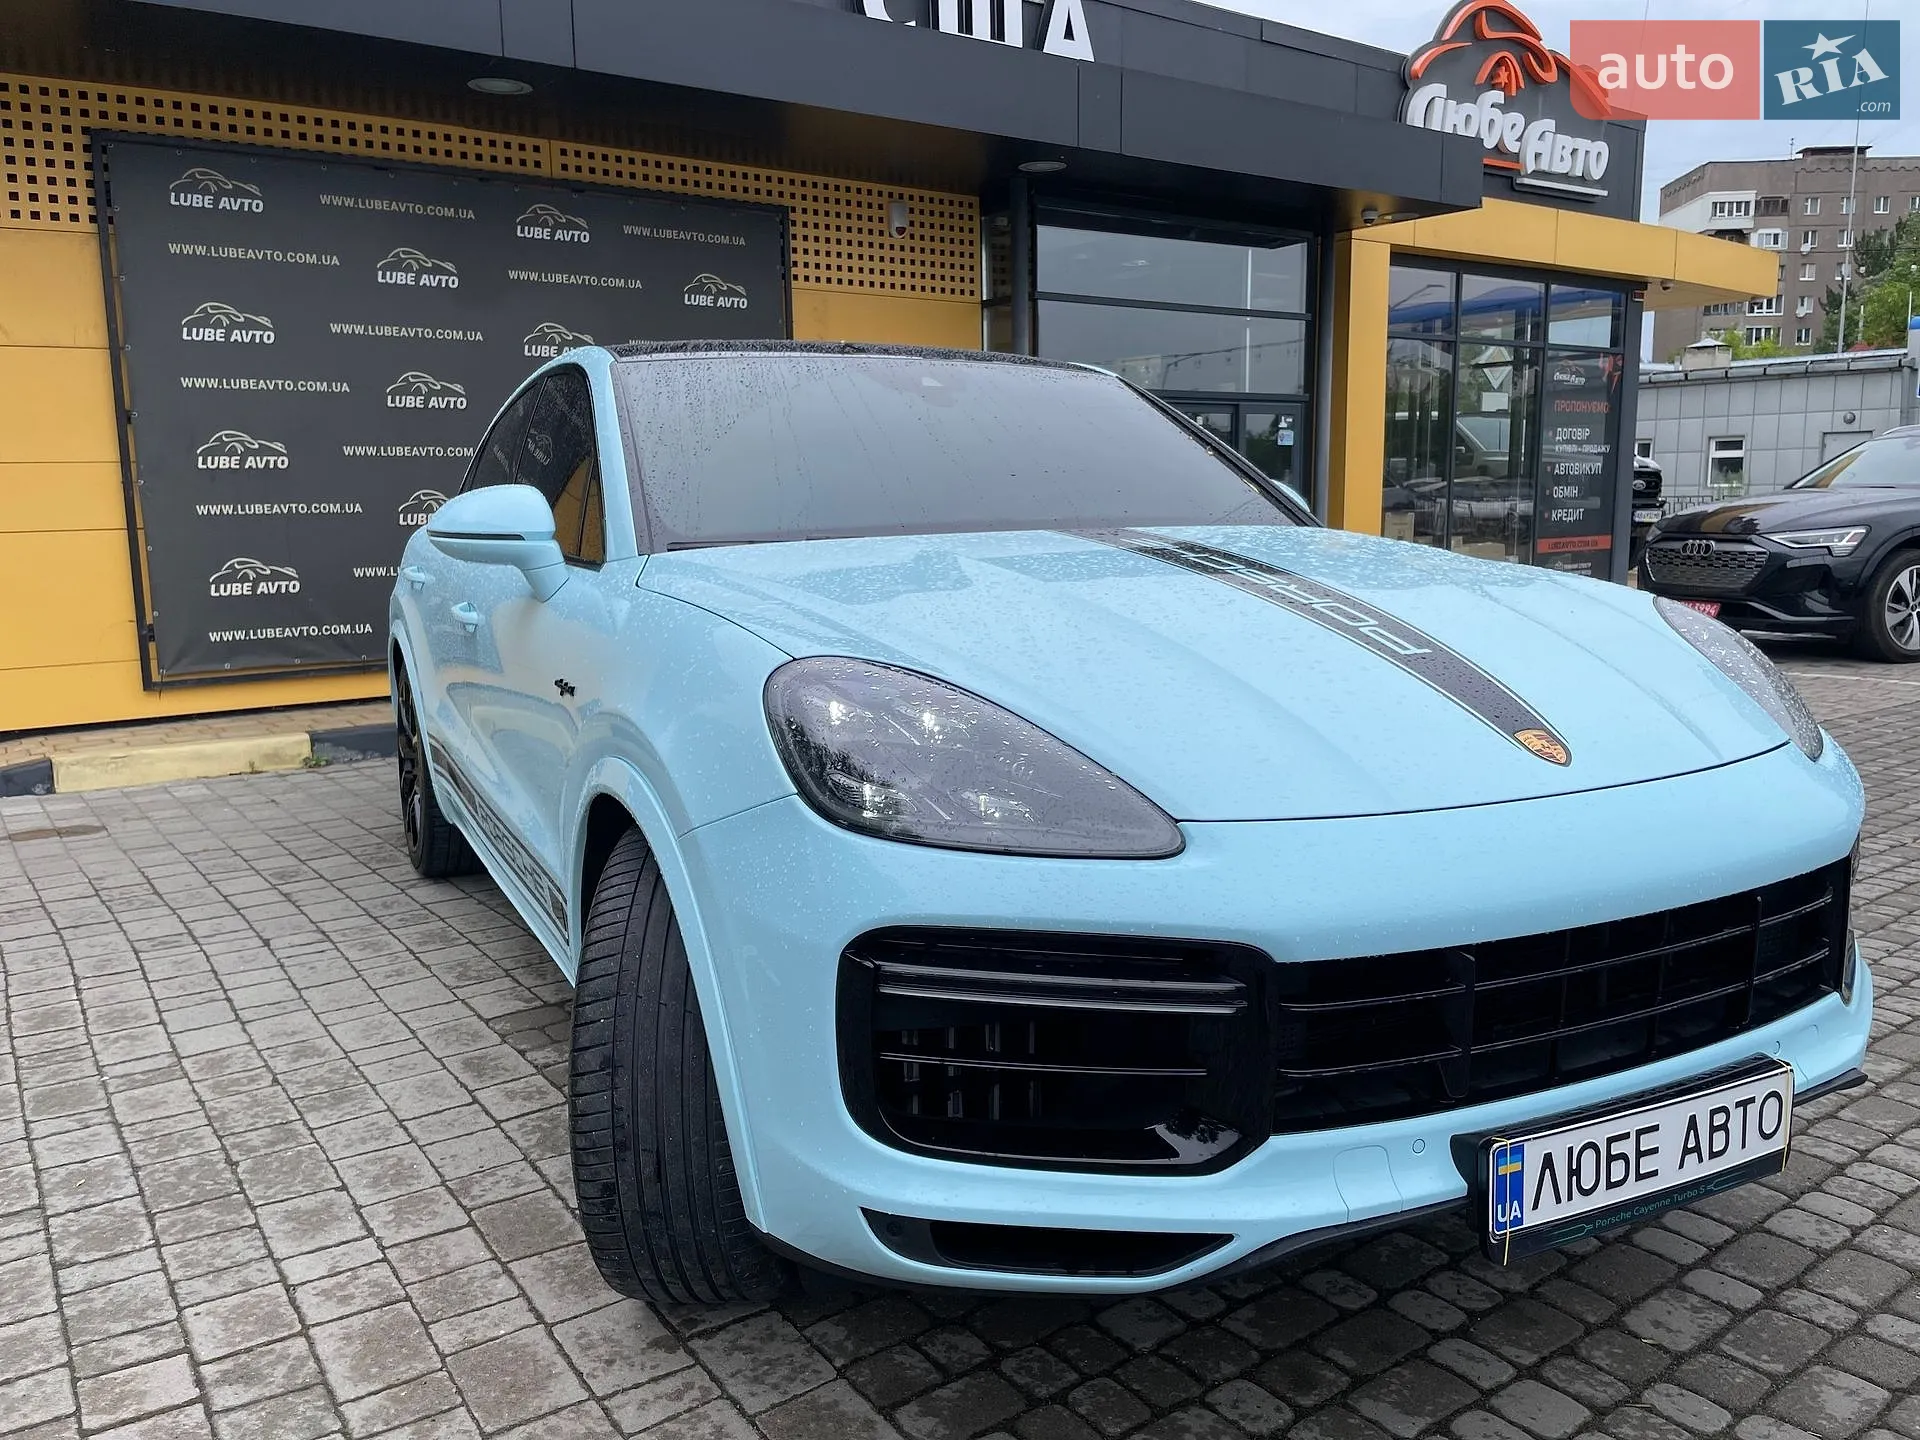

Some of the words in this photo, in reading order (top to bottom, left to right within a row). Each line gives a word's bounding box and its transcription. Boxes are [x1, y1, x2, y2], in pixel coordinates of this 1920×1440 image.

[1406, 83, 1525, 153] Любе
[1520, 119, 1610, 181] Авто
[171, 192, 213, 208] LUBE
[219, 197, 263, 212] AVTO
[320, 195, 475, 219] WWW.LUBEAVTO.COM.UA
[517, 226, 551, 239] LUBE
[554, 230, 589, 242] AVTO
[623, 225, 745, 246] WWW.LUBEAVTO.COM.UA
[169, 243, 339, 265] WWW.LUBEAVTO.COM.UA
[378, 271, 415, 285] LUBE
[420, 274, 458, 288] AVTO
[509, 270, 642, 288] WWW.LUBEAVTO.COM.UA
[684, 293, 714, 306] LUBE
[717, 297, 747, 308] AVTO
[183, 328, 225, 341] LUBE
[230, 330, 274, 343] AVTO
[330, 323, 483, 341] WWW.LUBEAVTO.COM.UA
[524, 345, 558, 357] LUBE
[181, 377, 349, 392] WWW.LUBEAVTO.COM.UA
[388, 396, 424, 408] LUBE
[428, 397, 466, 409] AVTO
[1556, 427, 1590, 441] ДОГОВІР
[343, 446, 473, 457] WWW.LUBEAVTO.COM
[198, 456, 240, 468] LUBE
[245, 456, 288, 468] AVTO
[1553, 463, 1602, 475] АВТОВИКУП
[1553, 486, 1578, 499] ОБМІН
[196, 503, 362, 515] WWW.LUBEAVTO.COM.UA
[1551, 508, 1584, 523] КРЕДИТ
[211, 582, 252, 596] LUBE
[257, 581, 300, 594] AVTO
[1119, 537, 1433, 656] PORSCHE
[209, 624, 372, 642] WWW.LUBEAVTO.COM.UA
[1531, 1123, 1661, 1211] ЛЮБЕ
[1678, 1090, 1784, 1171] АВТО
[1497, 1200, 1522, 1223] UA
[1595, 1210, 1631, 1229] Porsche
[1633, 1198, 1670, 1216] Cayenne
[1673, 1188, 1698, 1203] Turbo
